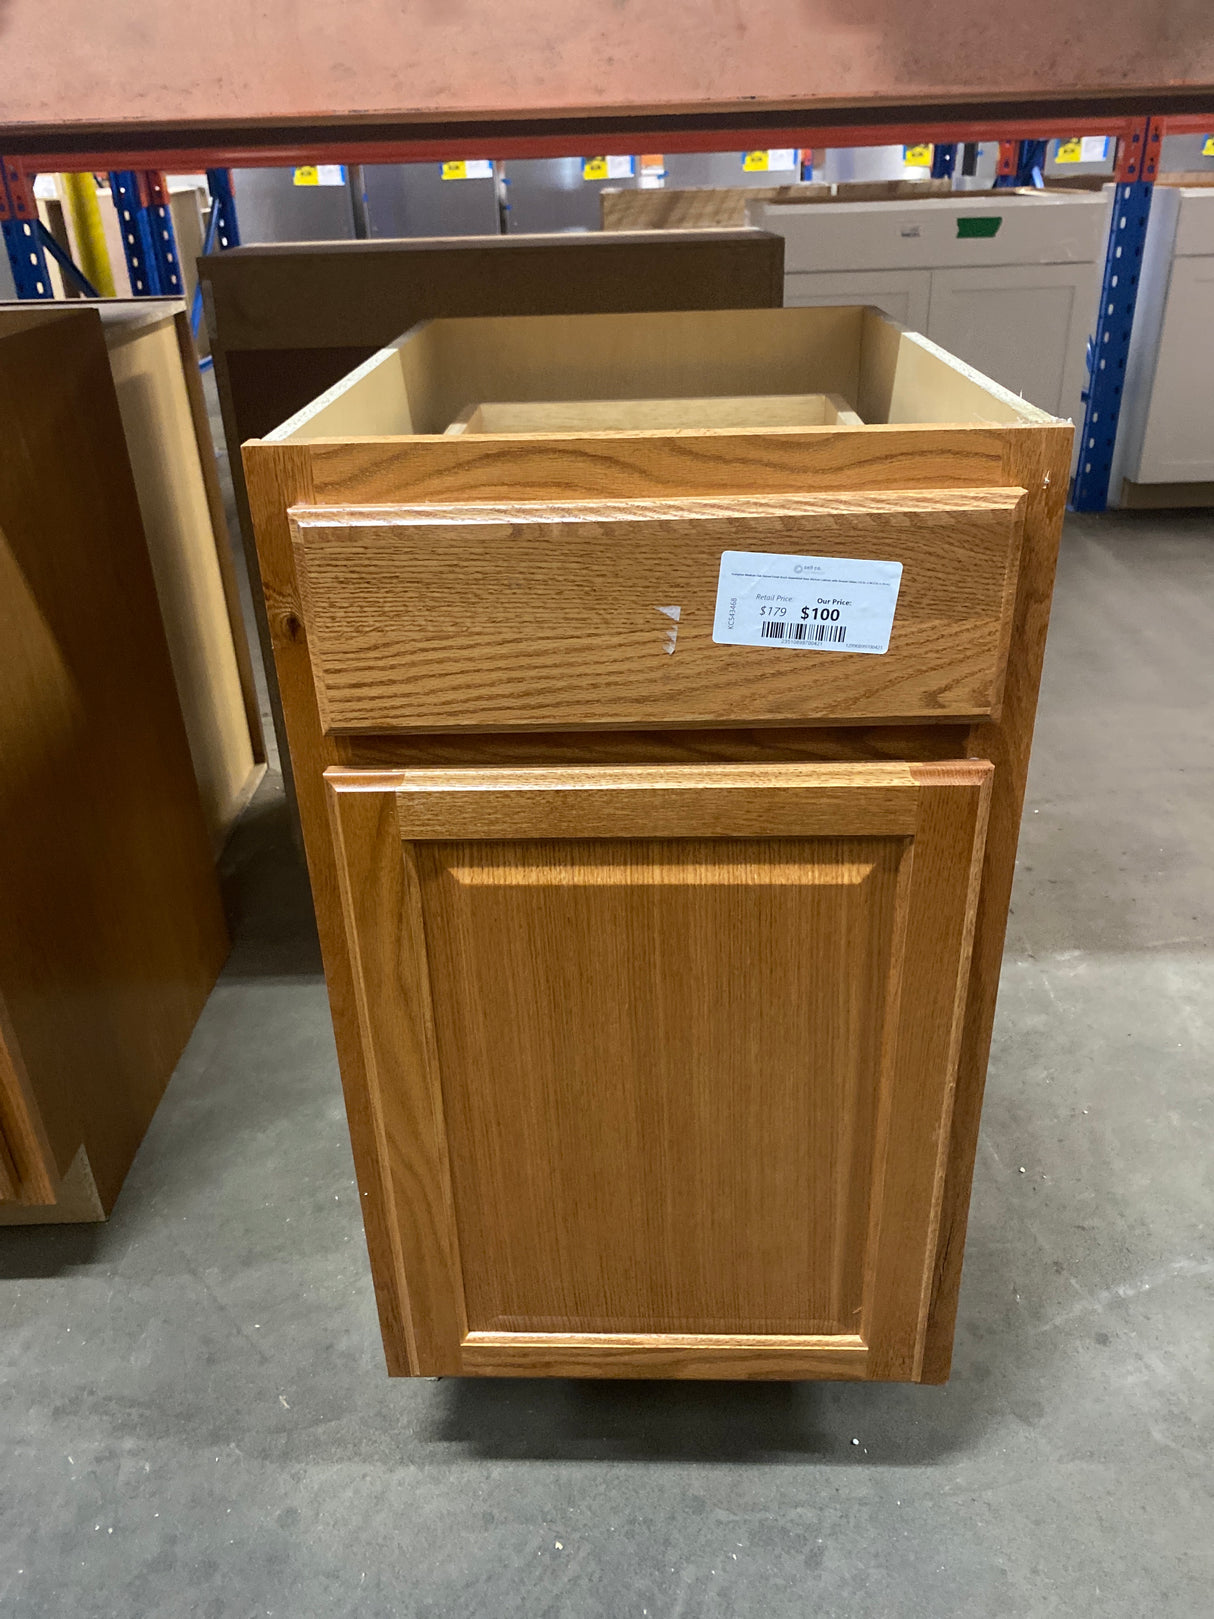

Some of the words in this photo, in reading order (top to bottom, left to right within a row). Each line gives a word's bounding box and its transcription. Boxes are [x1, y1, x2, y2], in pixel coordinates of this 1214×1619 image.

[756, 594, 774, 602] Retail
[817, 597, 830, 605] Our
[832, 598, 852, 606] Price:
[759, 605, 787, 616] $179
[800, 605, 840, 621] $100
